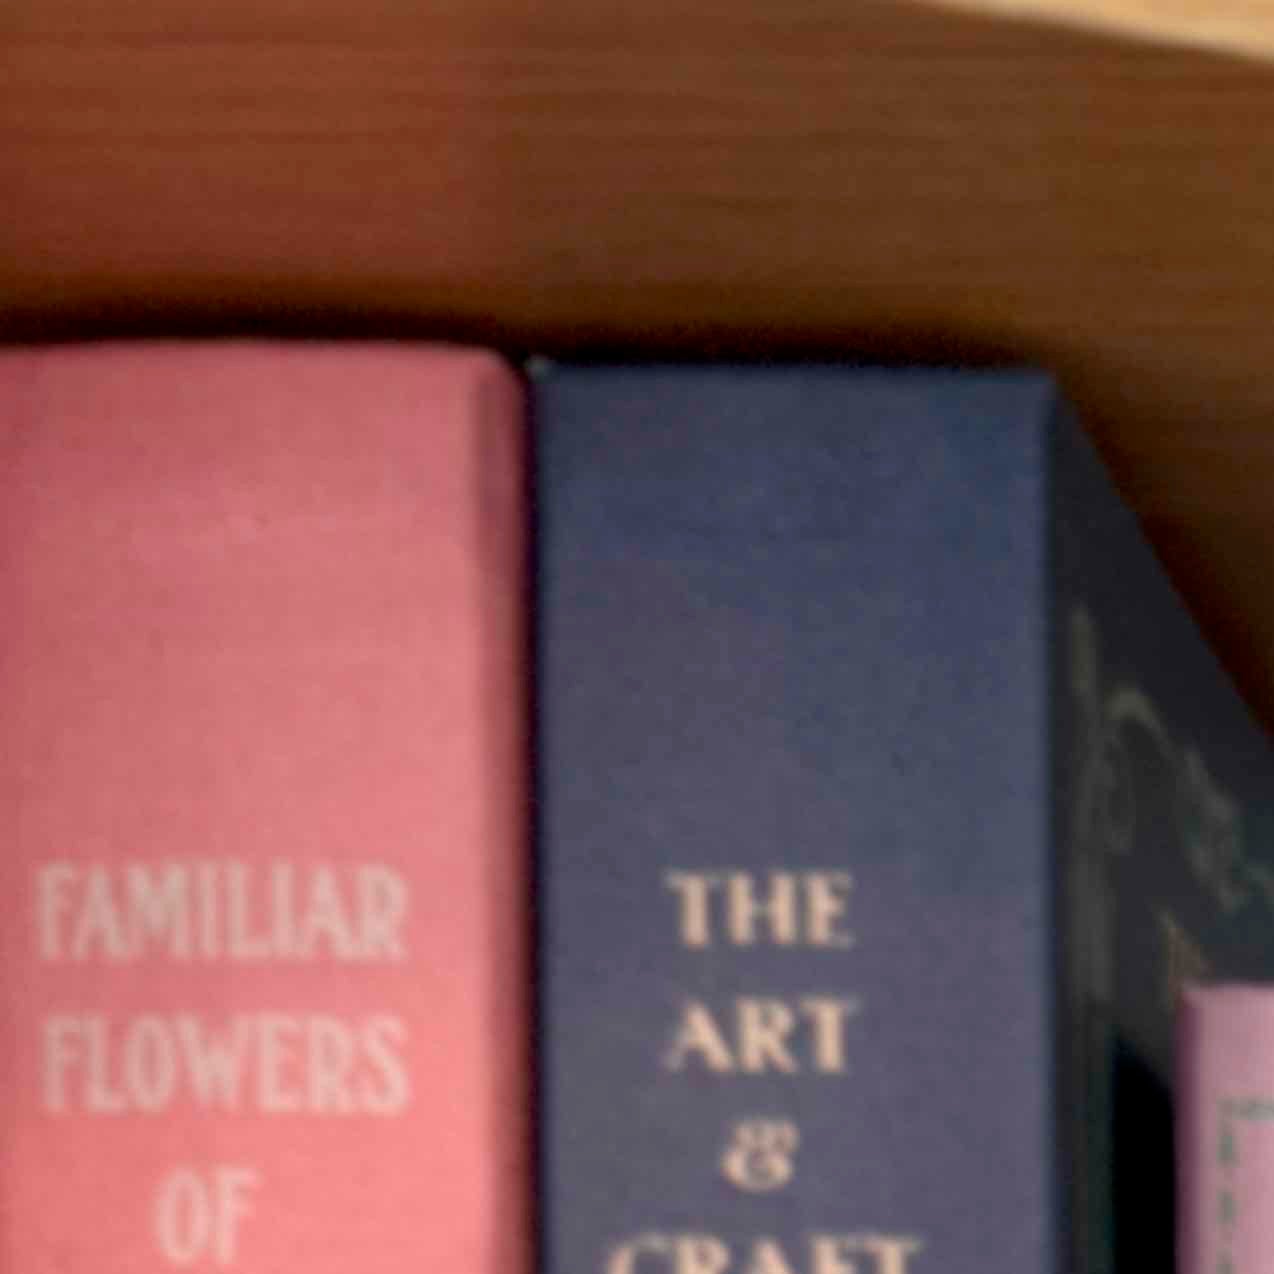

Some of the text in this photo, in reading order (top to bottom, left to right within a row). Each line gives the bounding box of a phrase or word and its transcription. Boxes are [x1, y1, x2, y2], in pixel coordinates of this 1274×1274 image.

[33, 862, 409, 964] FAMILIAR
[665, 870, 855, 948] THE
[38, 1014, 412, 1117] FLOWERS
[662, 997, 858, 1075] ART
[721, 1117, 800, 1191] &
[152, 1166, 260, 1267] OF
